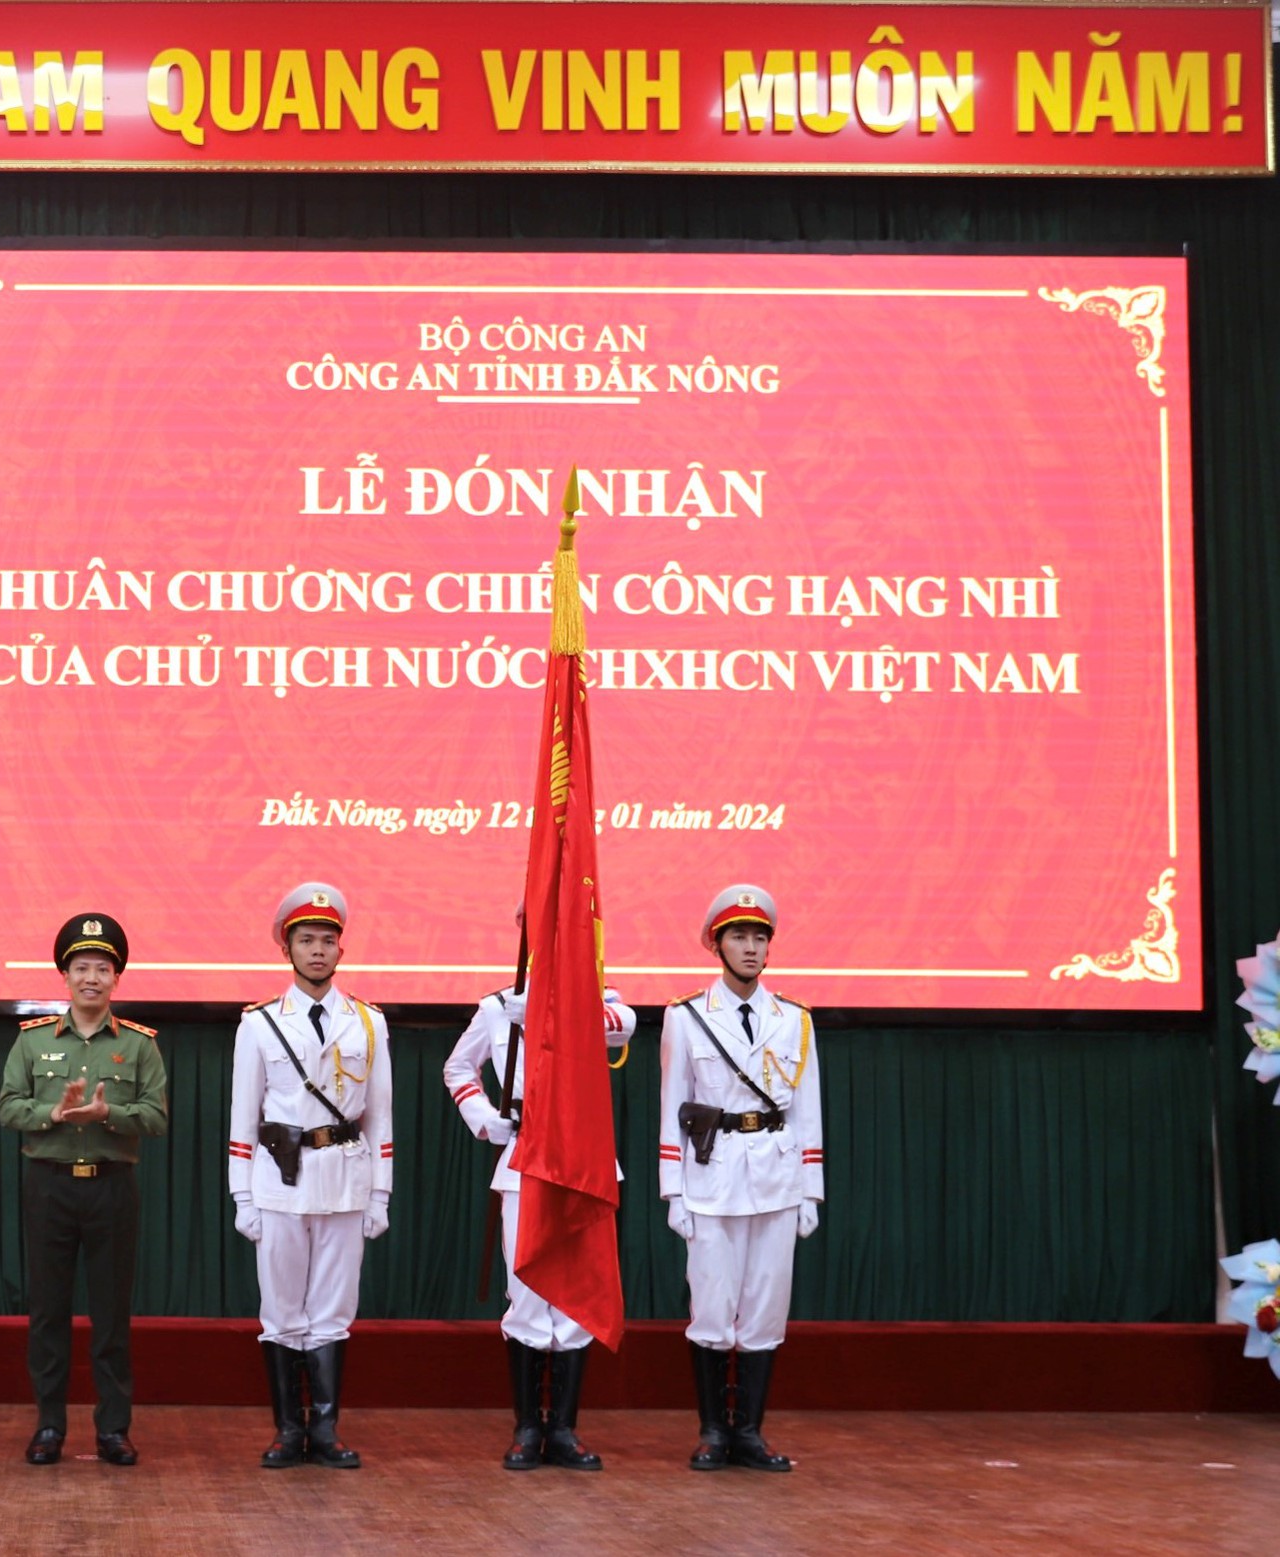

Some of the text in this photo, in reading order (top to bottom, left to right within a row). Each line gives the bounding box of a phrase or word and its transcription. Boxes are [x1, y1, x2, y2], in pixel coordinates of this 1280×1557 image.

[146, 47, 439, 146] QUANG
[482, 49, 681, 131] VINH
[723, 26, 976, 134] MUÔN
[1016, 31, 1243, 133] NĂM!
[418, 315, 648, 357] BỘ CÔNG AN
[285, 352, 782, 394] CÔNG AN TỈNH ĐẮK NÔNG
[298, 452, 768, 531] LỄ ĐÓN NHẬN
[167, 563, 414, 613] CHƯƠNG
[612, 560, 775, 616] CÔNG
[785, 575, 949, 628] HẠNG
[959, 565, 1061, 619] NHÌ
[103, 633, 224, 687] CHỦ
[234, 645, 372, 699] TỊCH
[383, 635, 547, 689] NƯỚC
[808, 644, 941, 704] VIỆT
[949, 651, 1082, 694] NAM
[258, 791, 321, 827] Đắk
[323, 798, 408, 836] Nông,
[412, 804, 483, 836] ngày
[488, 801, 521, 829] 12
[610, 802, 643, 829] 01
[649, 801, 713, 830] năm
[717, 802, 786, 830] 2024
